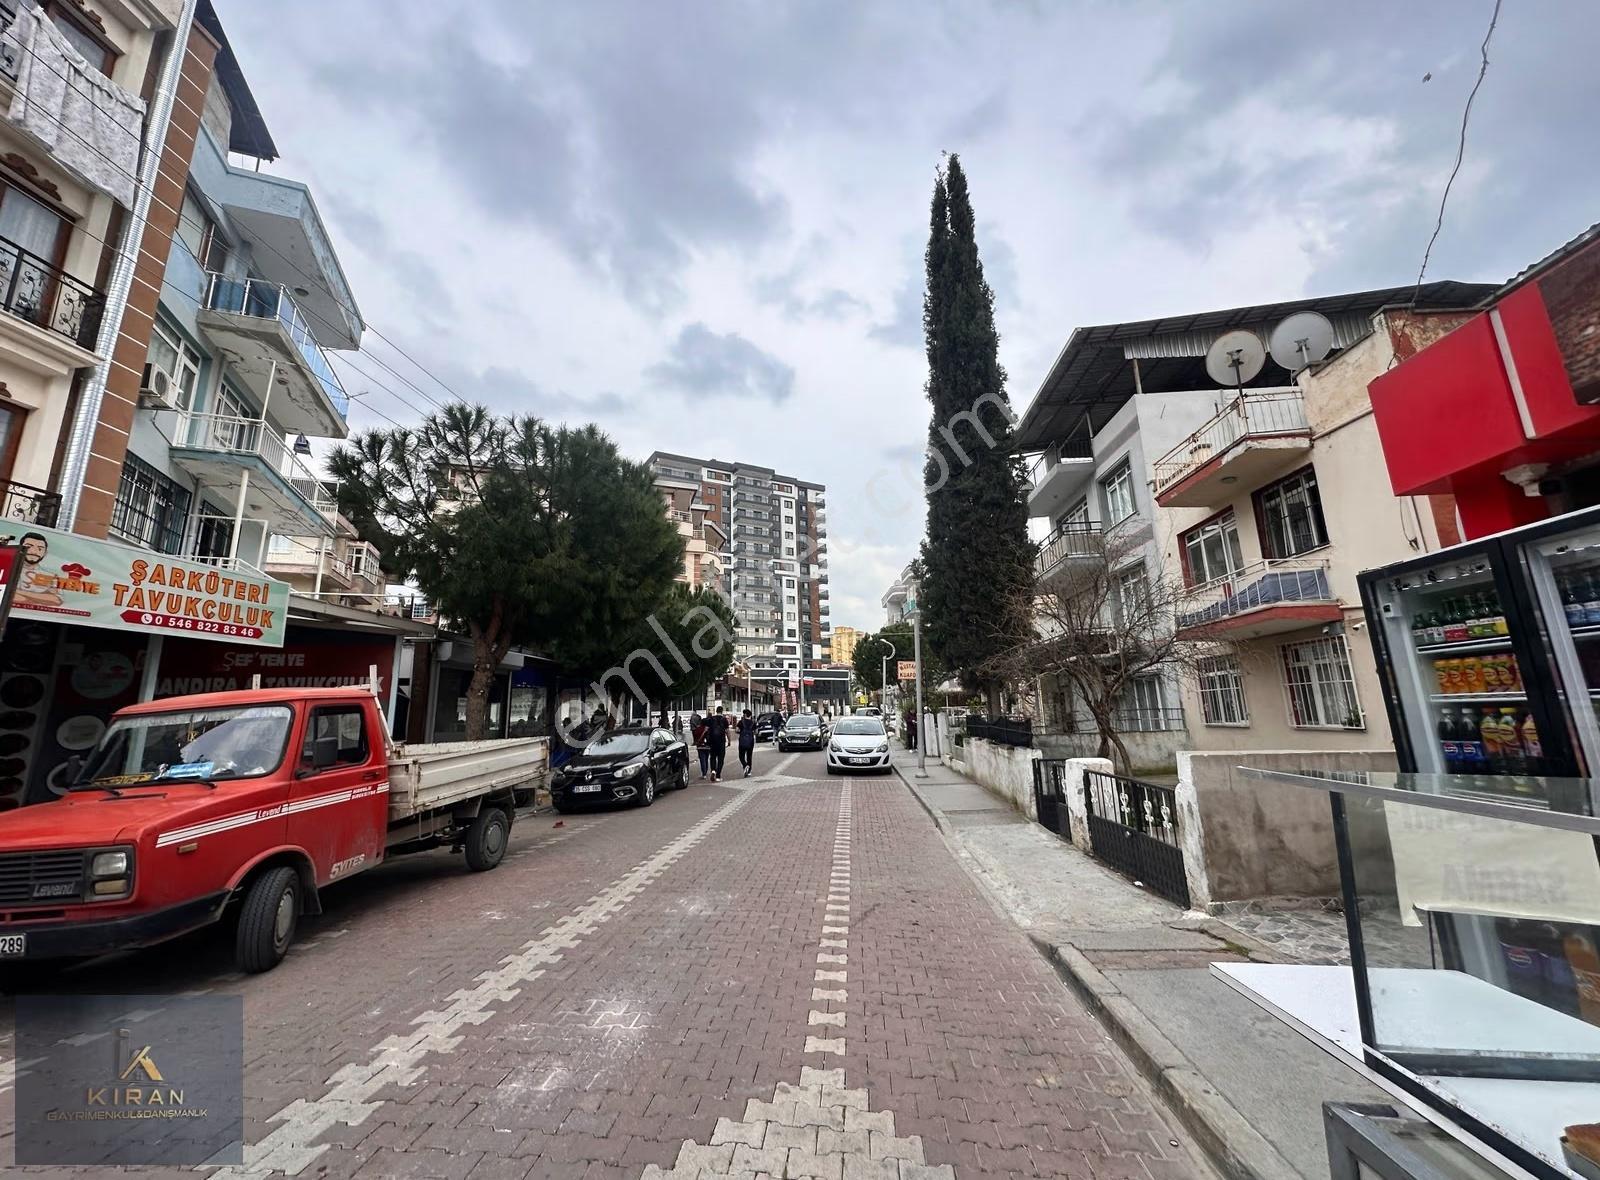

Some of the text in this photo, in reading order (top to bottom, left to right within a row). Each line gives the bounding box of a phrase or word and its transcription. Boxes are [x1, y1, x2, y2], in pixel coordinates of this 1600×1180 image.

[130, 559, 269, 605] ŞARKÜTERİ
[155, 617, 254, 637] 0 546 822 83 46
[155, 676, 238, 697] ANDIRA
[258, 805, 282, 819] Levend
[32, 881, 76, 897] Levend
[0, 937, 23, 953] 289
